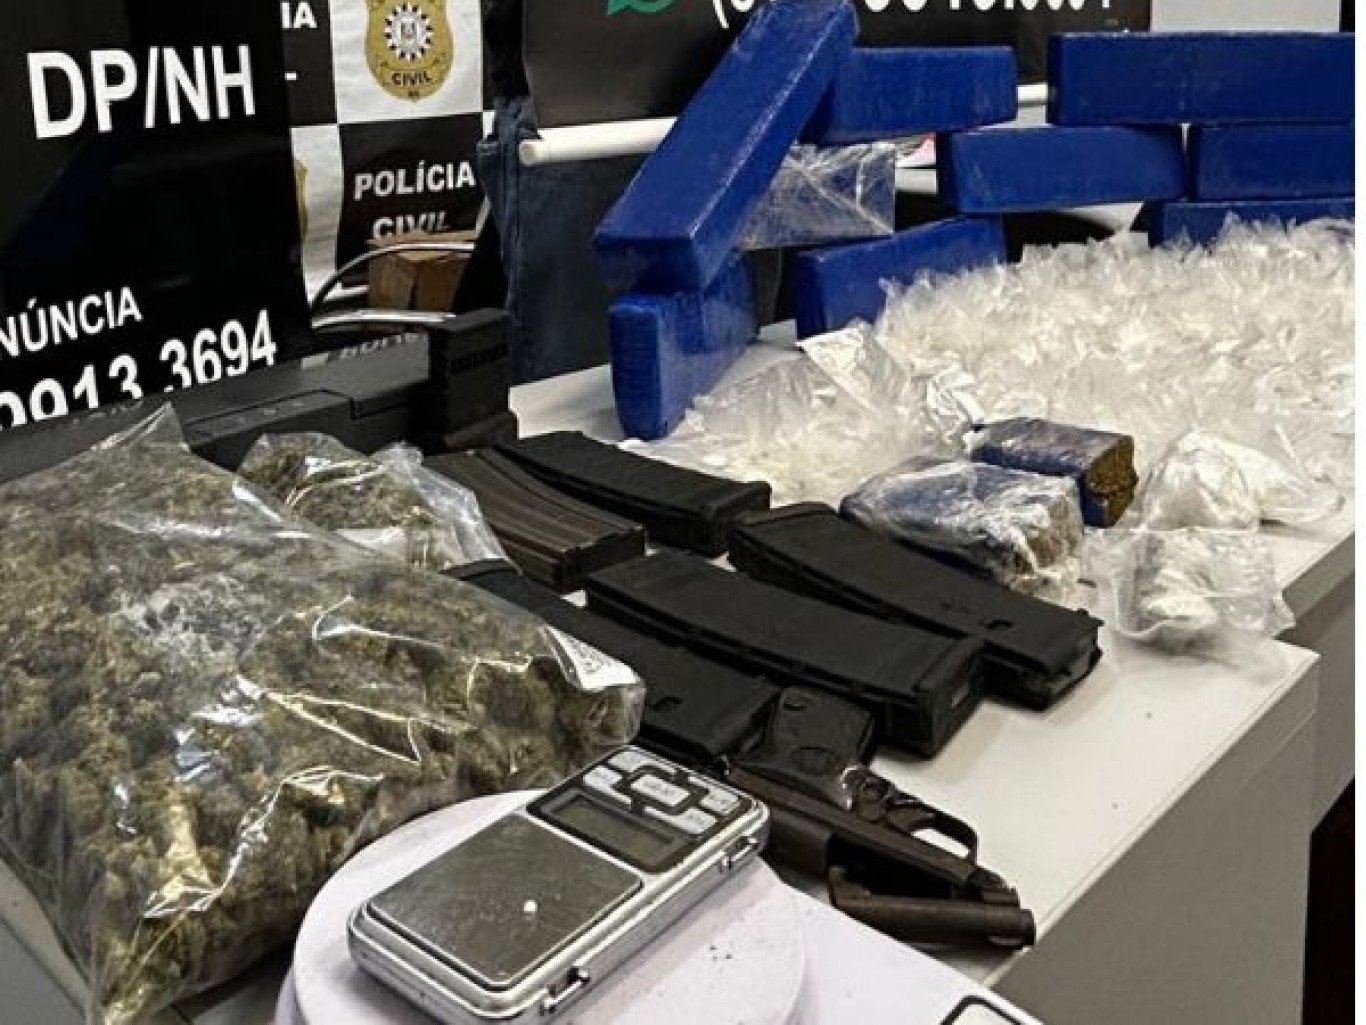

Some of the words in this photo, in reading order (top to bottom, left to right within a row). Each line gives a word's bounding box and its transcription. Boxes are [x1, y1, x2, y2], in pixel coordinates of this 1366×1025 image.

[27, 45, 256, 140] DP/NH
[354, 161, 476, 201] POLÍCIA
[0, 286, 143, 357] NÚNCIA
